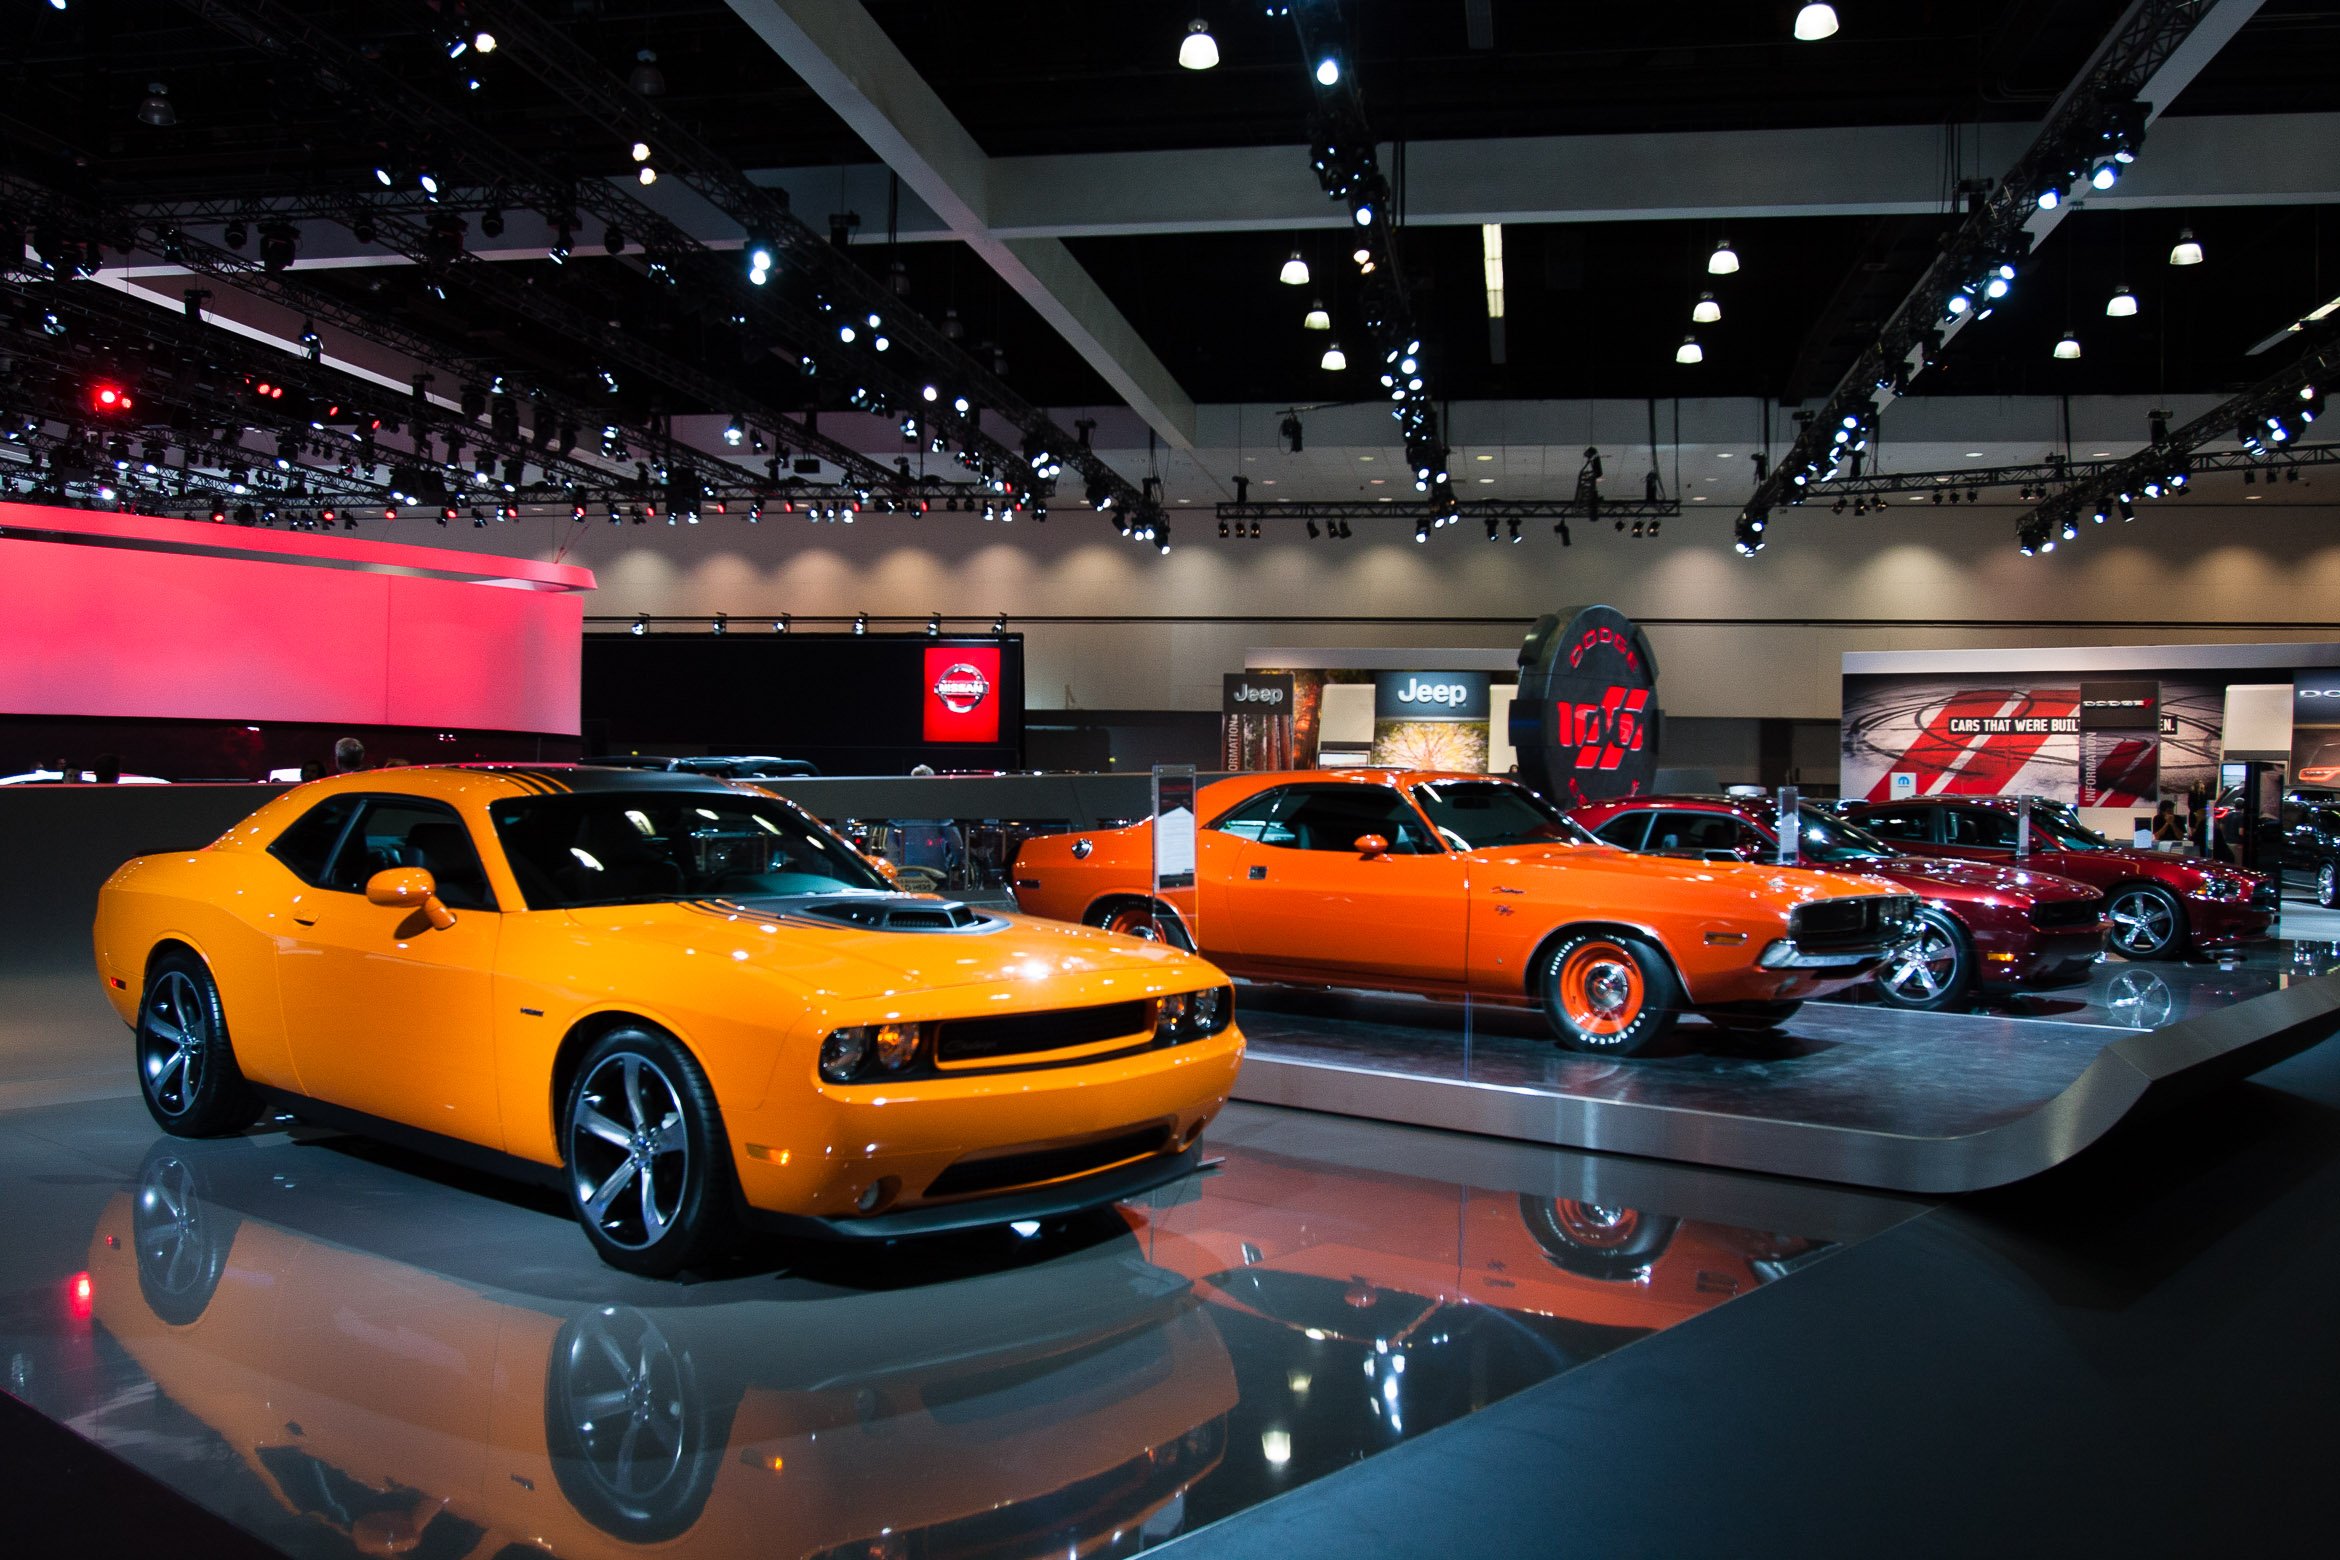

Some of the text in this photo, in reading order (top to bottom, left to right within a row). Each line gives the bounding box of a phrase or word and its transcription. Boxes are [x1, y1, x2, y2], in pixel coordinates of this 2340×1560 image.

[1569, 627, 1639, 673] DODGE
[1233, 683, 1284, 706] Jeep
[1398, 678, 1467, 708] Jeep
[1950, 719, 1981, 732] CARS
[1983, 719, 2012, 732] THAT
[2014, 719, 2048, 732] WERE
[2051, 719, 2080, 732] BUIL
[2085, 732, 2097, 802] INFORMATION
